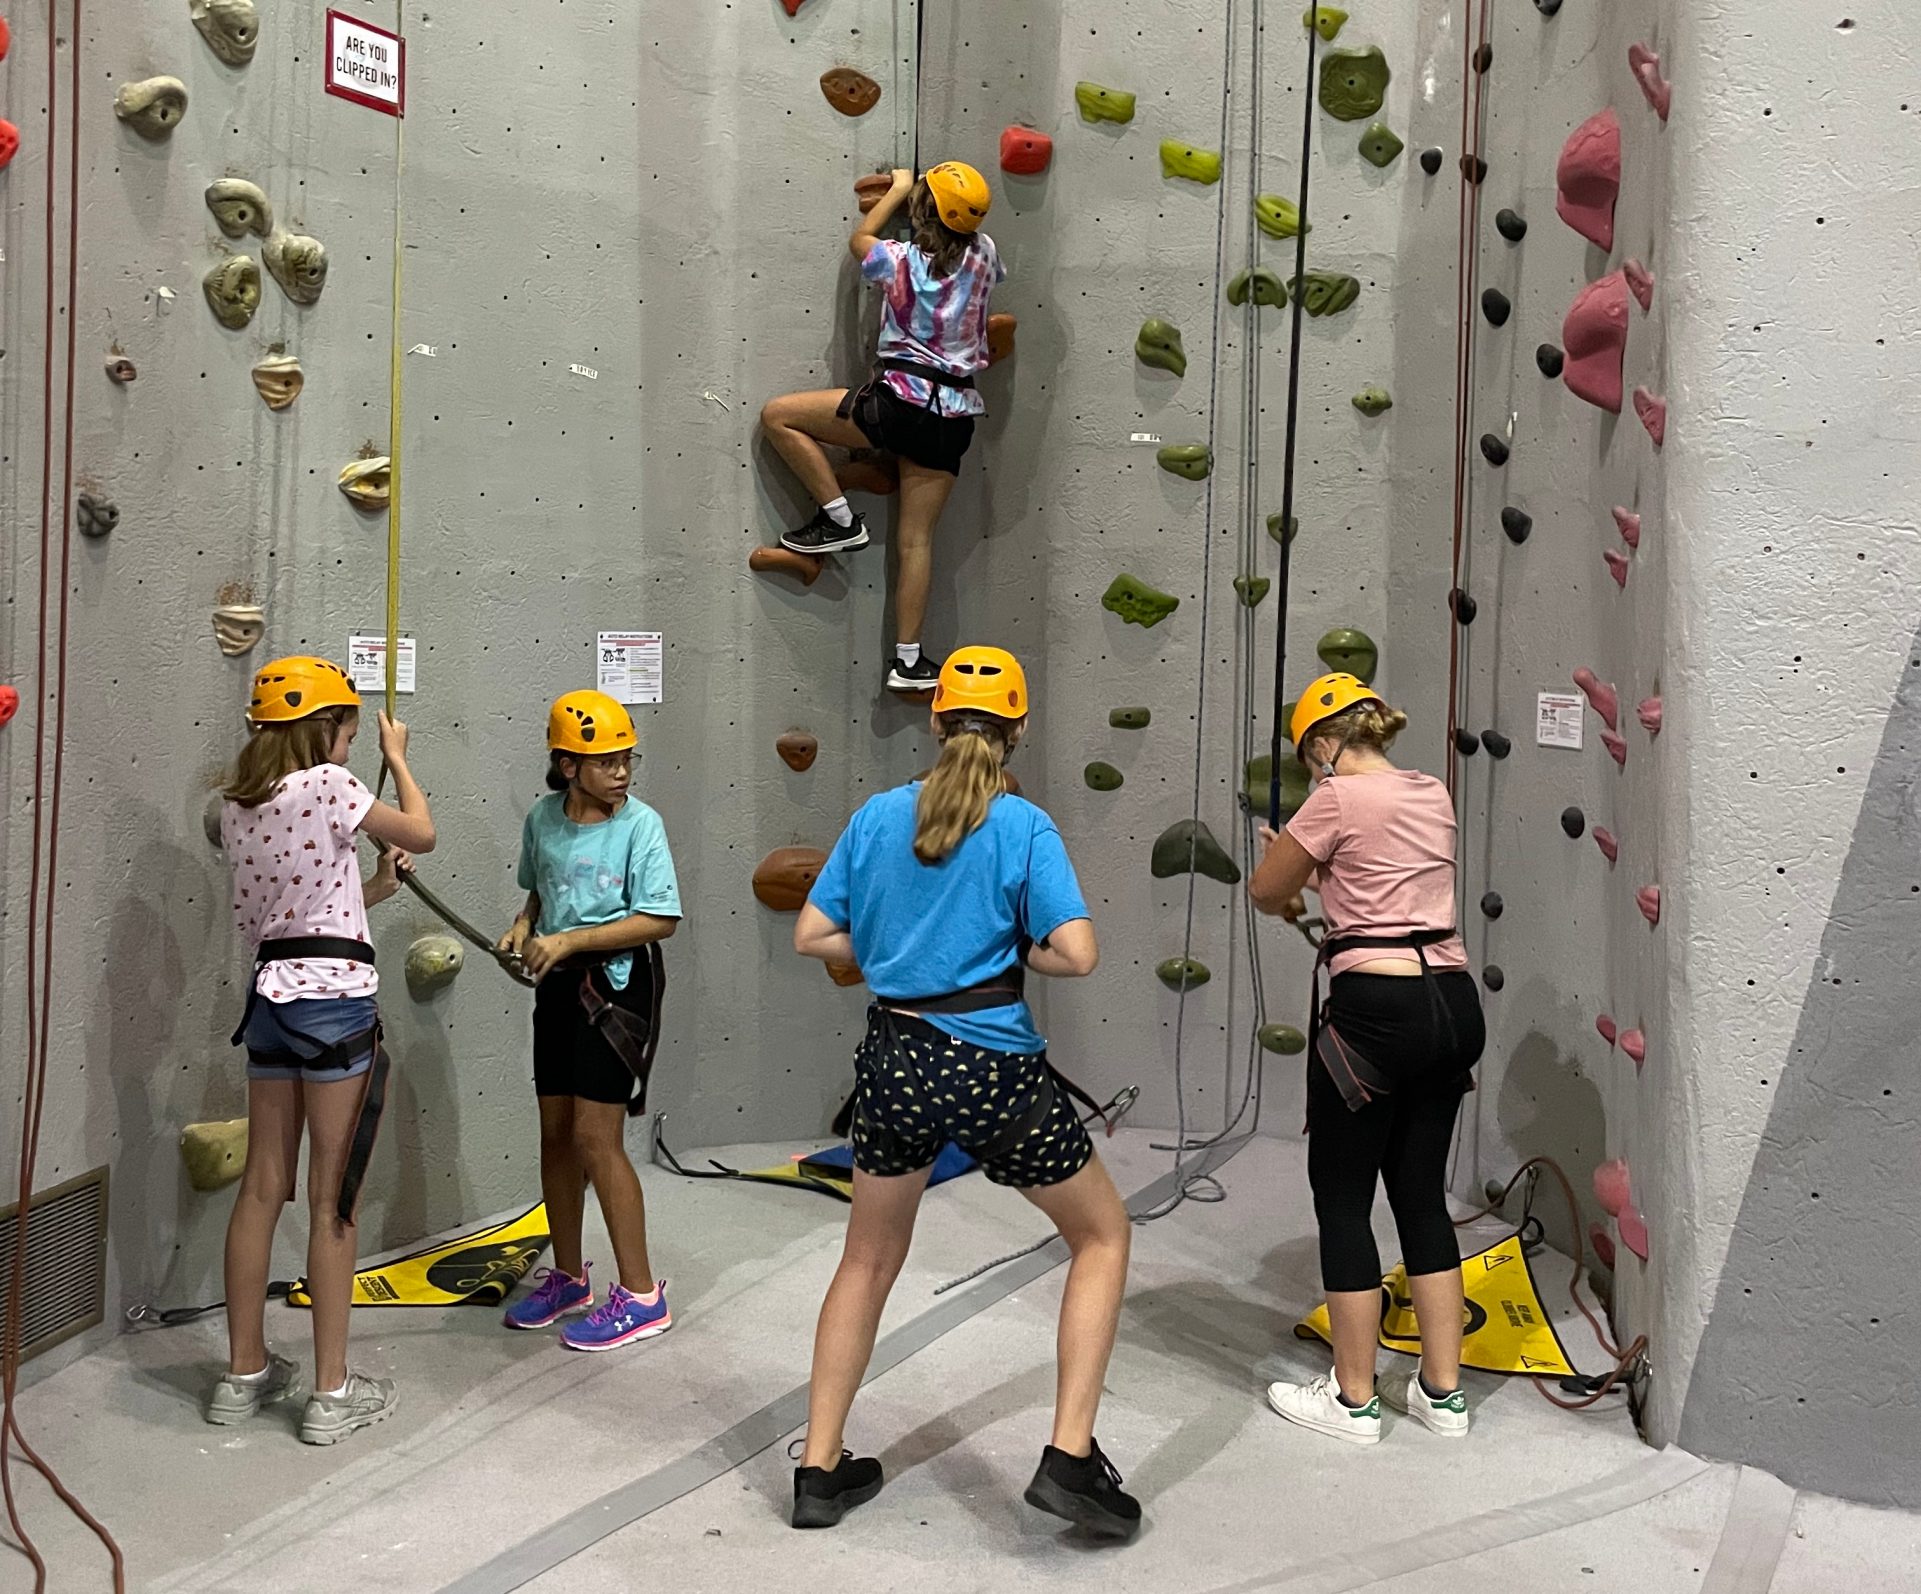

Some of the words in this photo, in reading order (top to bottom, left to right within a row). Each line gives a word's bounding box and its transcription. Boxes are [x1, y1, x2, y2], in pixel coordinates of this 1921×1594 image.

[345, 36, 366, 56] ARE
[368, 43, 388, 63] YOU
[336, 56, 378, 83] CLIPPED
[380, 71, 397, 90] IN?
